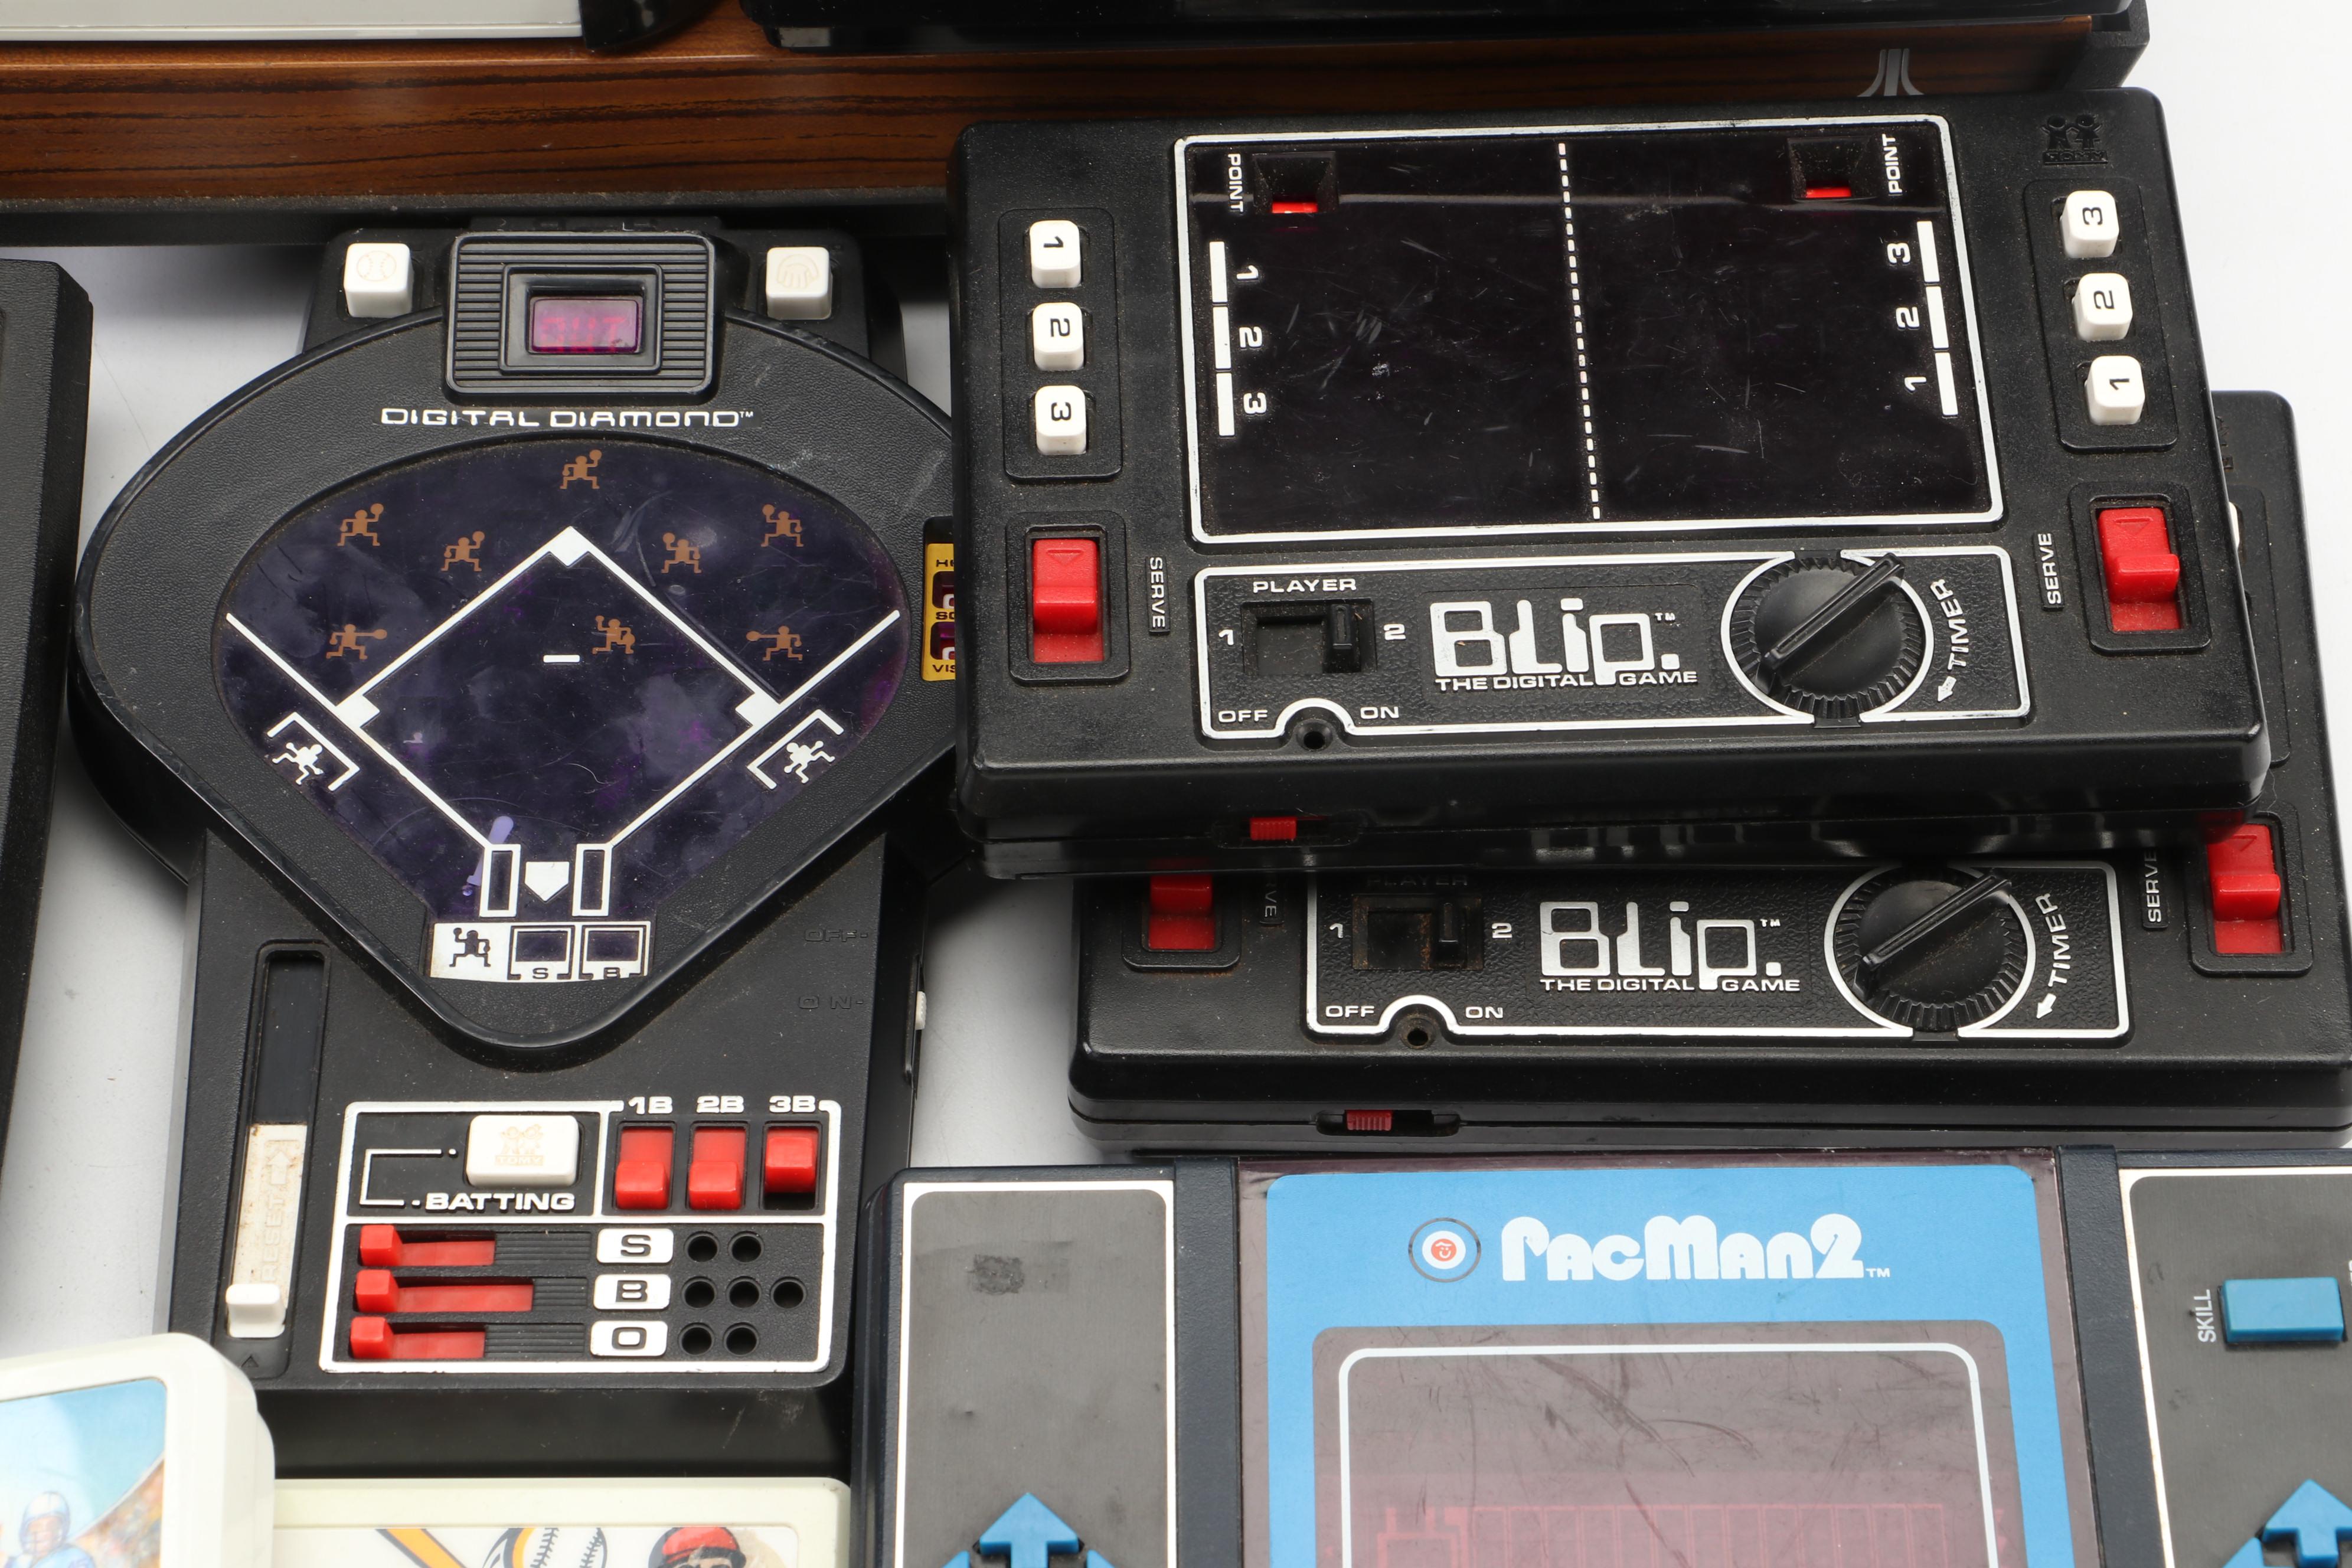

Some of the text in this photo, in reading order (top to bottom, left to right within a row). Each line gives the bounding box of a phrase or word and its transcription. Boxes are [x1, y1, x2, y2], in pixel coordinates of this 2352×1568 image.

[1882, 133, 1903, 194] POINT
[1227, 153, 1243, 212] POINT
[2082, 207, 2103, 226] 3
[1043, 236, 1064, 248] 1
[1887, 243, 1911, 263] 3
[1236, 265, 1259, 280] 1
[2093, 290, 2115, 309] 2
[1896, 306, 1920, 328] 2
[1050, 318, 1070, 337] 2
[1239, 326, 1263, 348] 2
[1904, 377, 1927, 391] 1
[2109, 378, 2129, 390] 1
[1051, 402, 1072, 422] 3
[1243, 392, 1267, 414] 3
[381, 408, 540, 427] DIGITAL
[2038, 533, 2063, 605] SERVE
[1149, 557, 1165, 628] SERVE
[1253, 578, 1357, 593] PLAYER
[1383, 623, 1406, 641] 2
[1929, 579, 1969, 670] TIMER
[1219, 629, 1234, 645] 1
[1435, 669, 1697, 691] THE DIGITAL GAME
[1218, 709, 1268, 723] OFF
[1360, 706, 1399, 720] ON
[1329, 923, 1344, 939] 1
[1491, 923, 1513, 939] 2
[2036, 893, 2072, 987] TIMER
[532, 967, 549, 979] S
[603, 967, 620, 978] B
[1540, 978, 1800, 991] THE DIGITAL GAME
[1325, 1005, 1375, 1018] OFF
[1465, 1006, 1503, 1018] ON
[628, 1096, 673, 1115] 1B
[696, 1095, 744, 1113] 2B
[769, 1095, 816, 1113] 3B
[496, 1155, 543, 1165] TOMY
[425, 1192, 575, 1211] BATTING
[620, 1234, 651, 1257] S
[615, 1280, 648, 1302] B
[2193, 1289, 2216, 1342] SKILL
